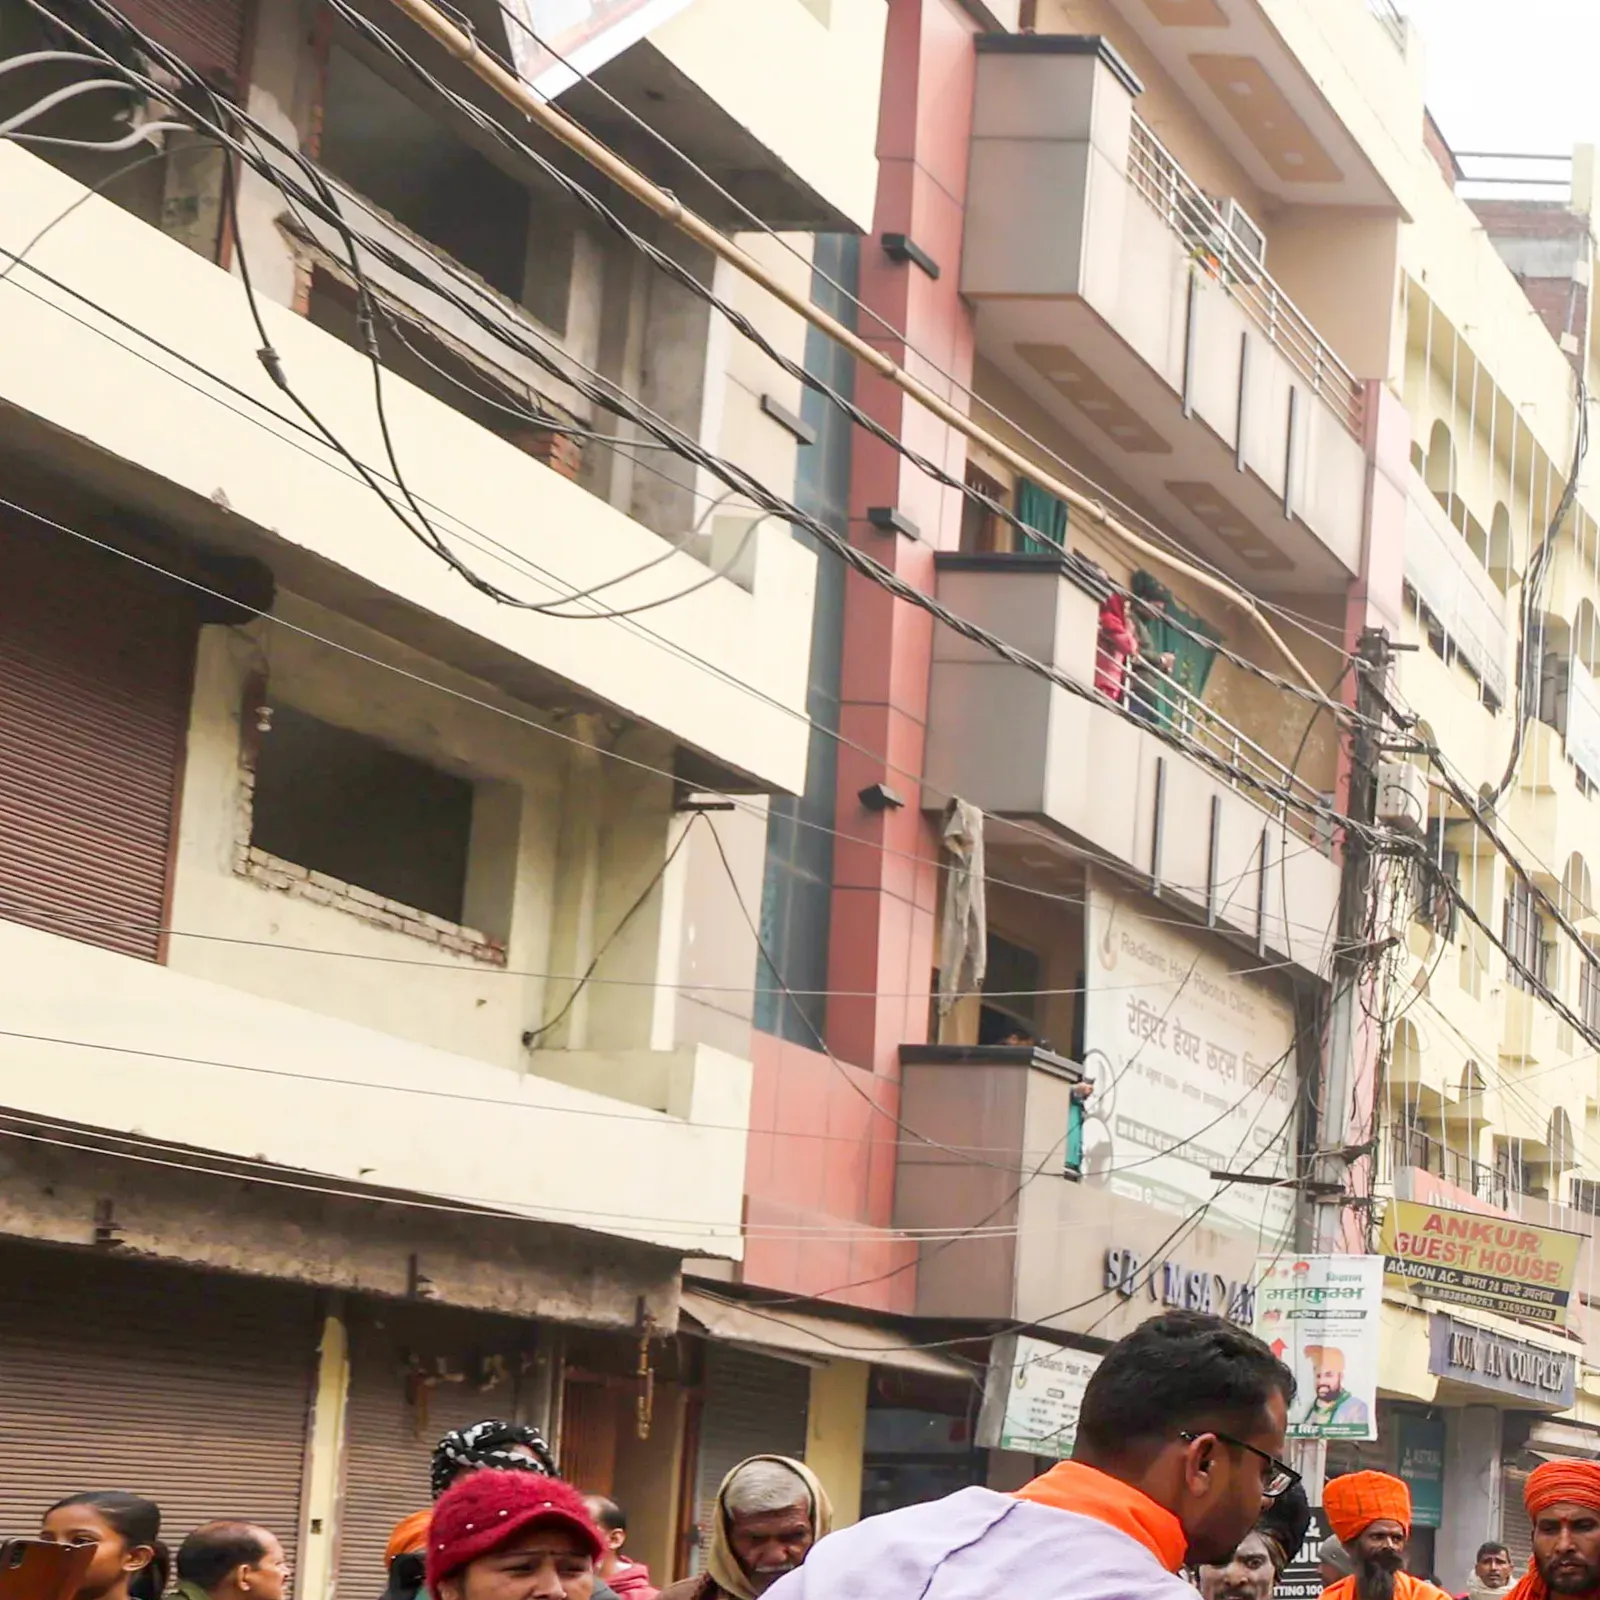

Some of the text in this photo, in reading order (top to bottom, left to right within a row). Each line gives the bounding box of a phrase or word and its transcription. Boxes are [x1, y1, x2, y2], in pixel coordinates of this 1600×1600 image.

[1121, 932, 1166, 974] Radiant
[1169, 954, 1189, 985] Hair
[1423, 1214, 1540, 1252] ANKUR
[1394, 1233, 1561, 1284] GUEST HOUSE
[1509, 1351, 1565, 1392] COMPLEX
[1273, 1585, 1305, 1596] TTING
